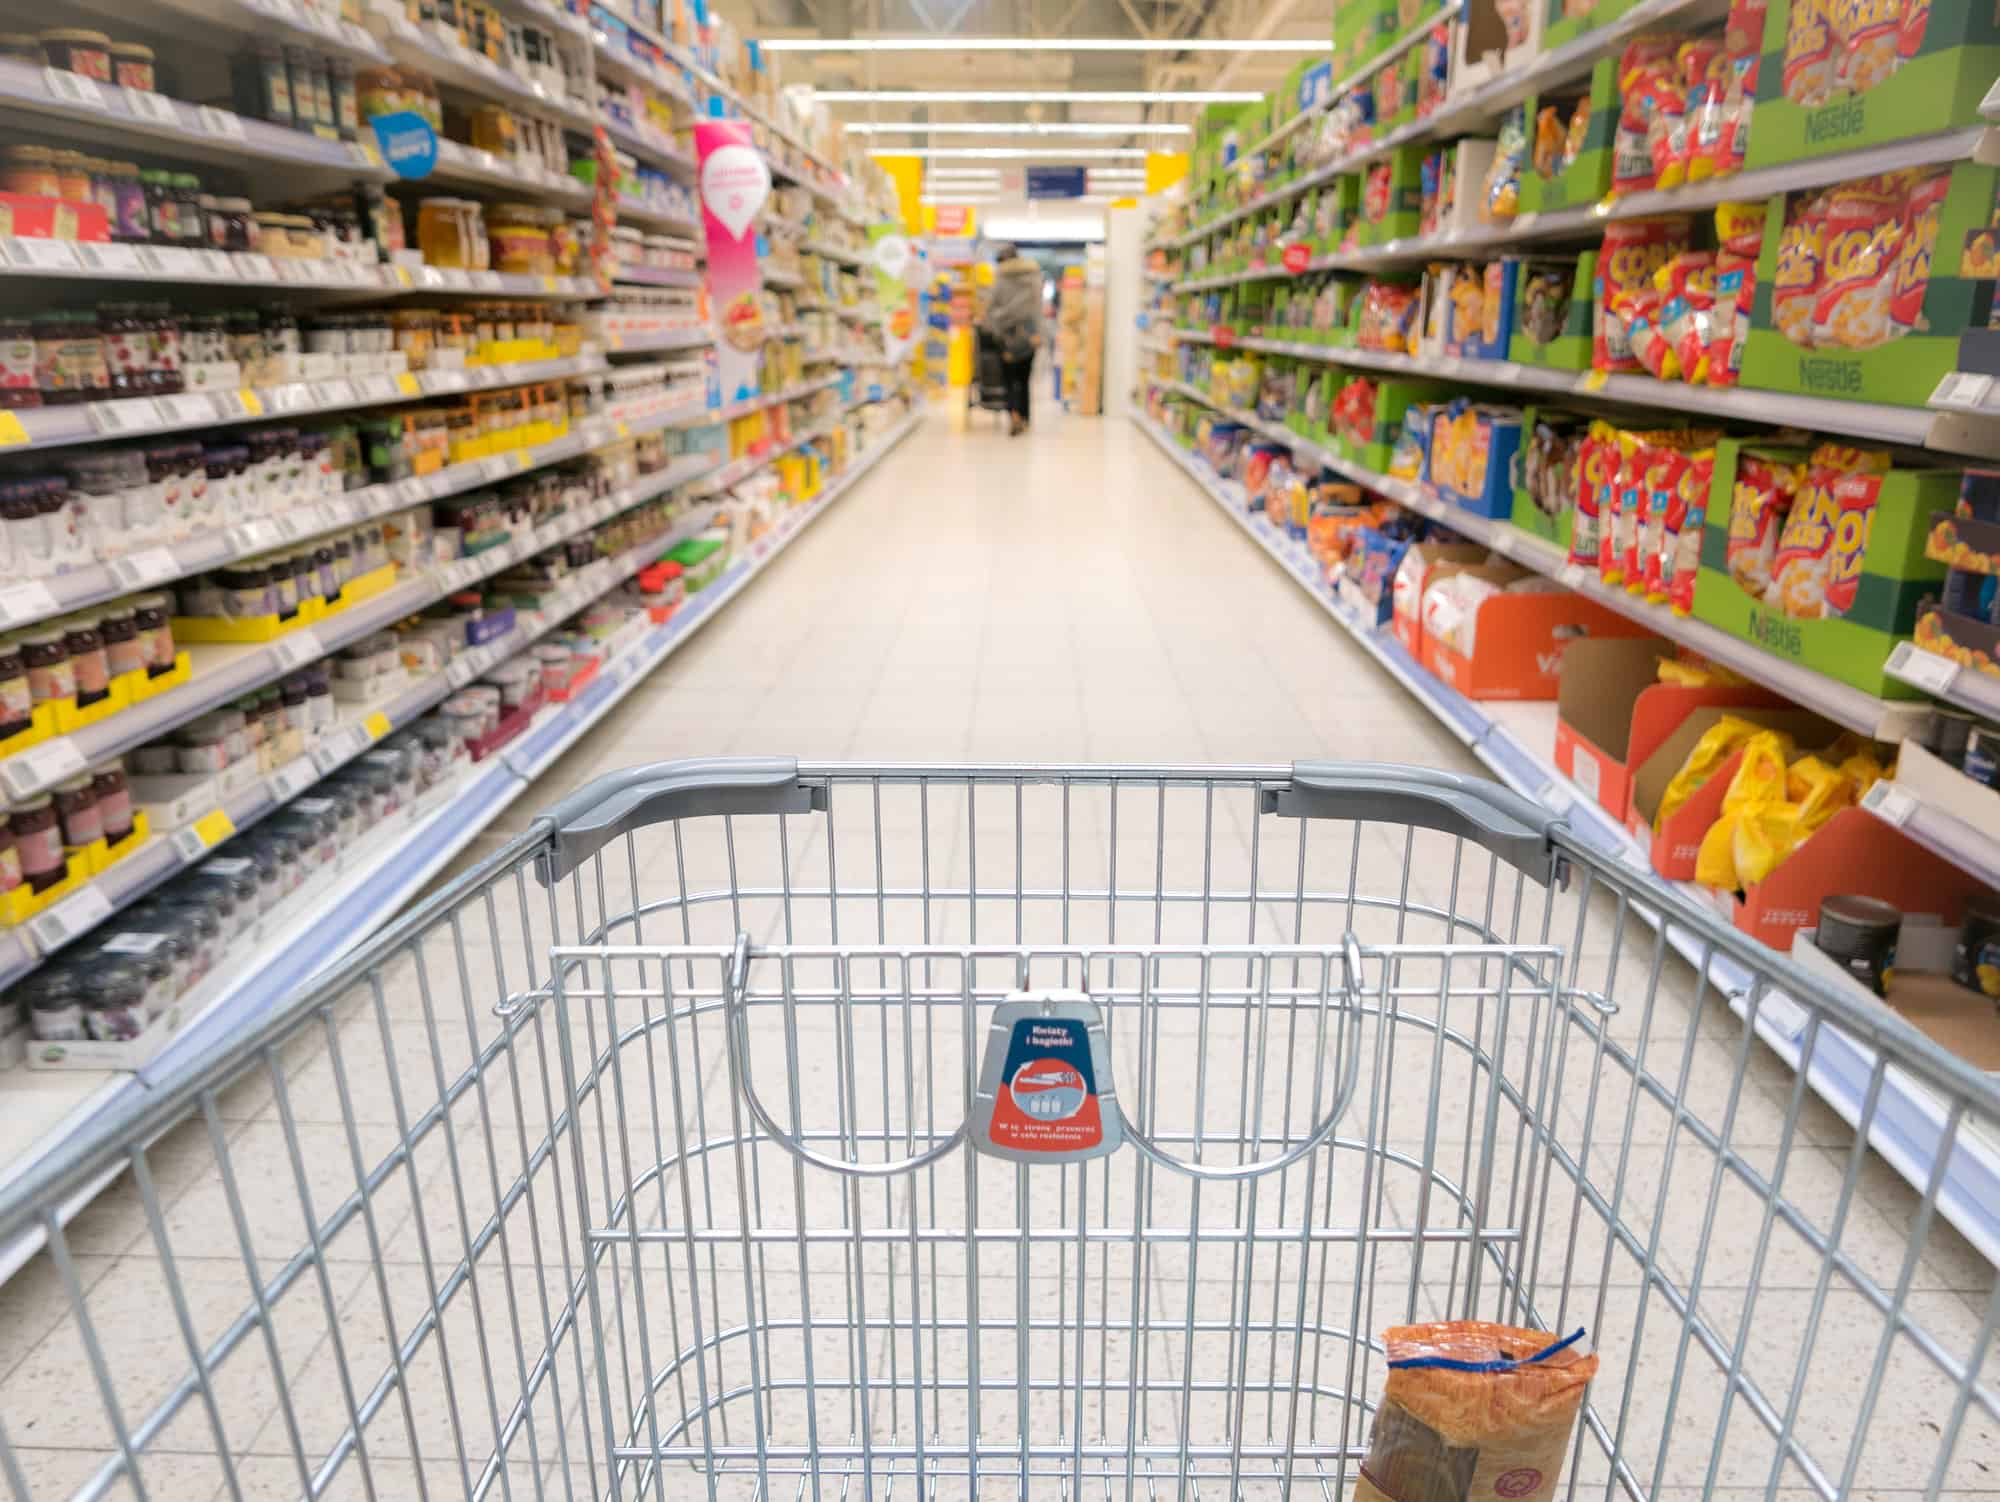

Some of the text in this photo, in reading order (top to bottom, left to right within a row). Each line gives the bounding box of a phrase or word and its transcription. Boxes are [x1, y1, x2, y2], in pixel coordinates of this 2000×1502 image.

[1804, 98, 1865, 144] Nestlé
[1800, 358, 1863, 393] Nestlé
[1751, 607, 1802, 656] Nestlé
[1033, 1025, 1068, 1037] Kwiaty
[1033, 1036, 1073, 1049] bagietki
